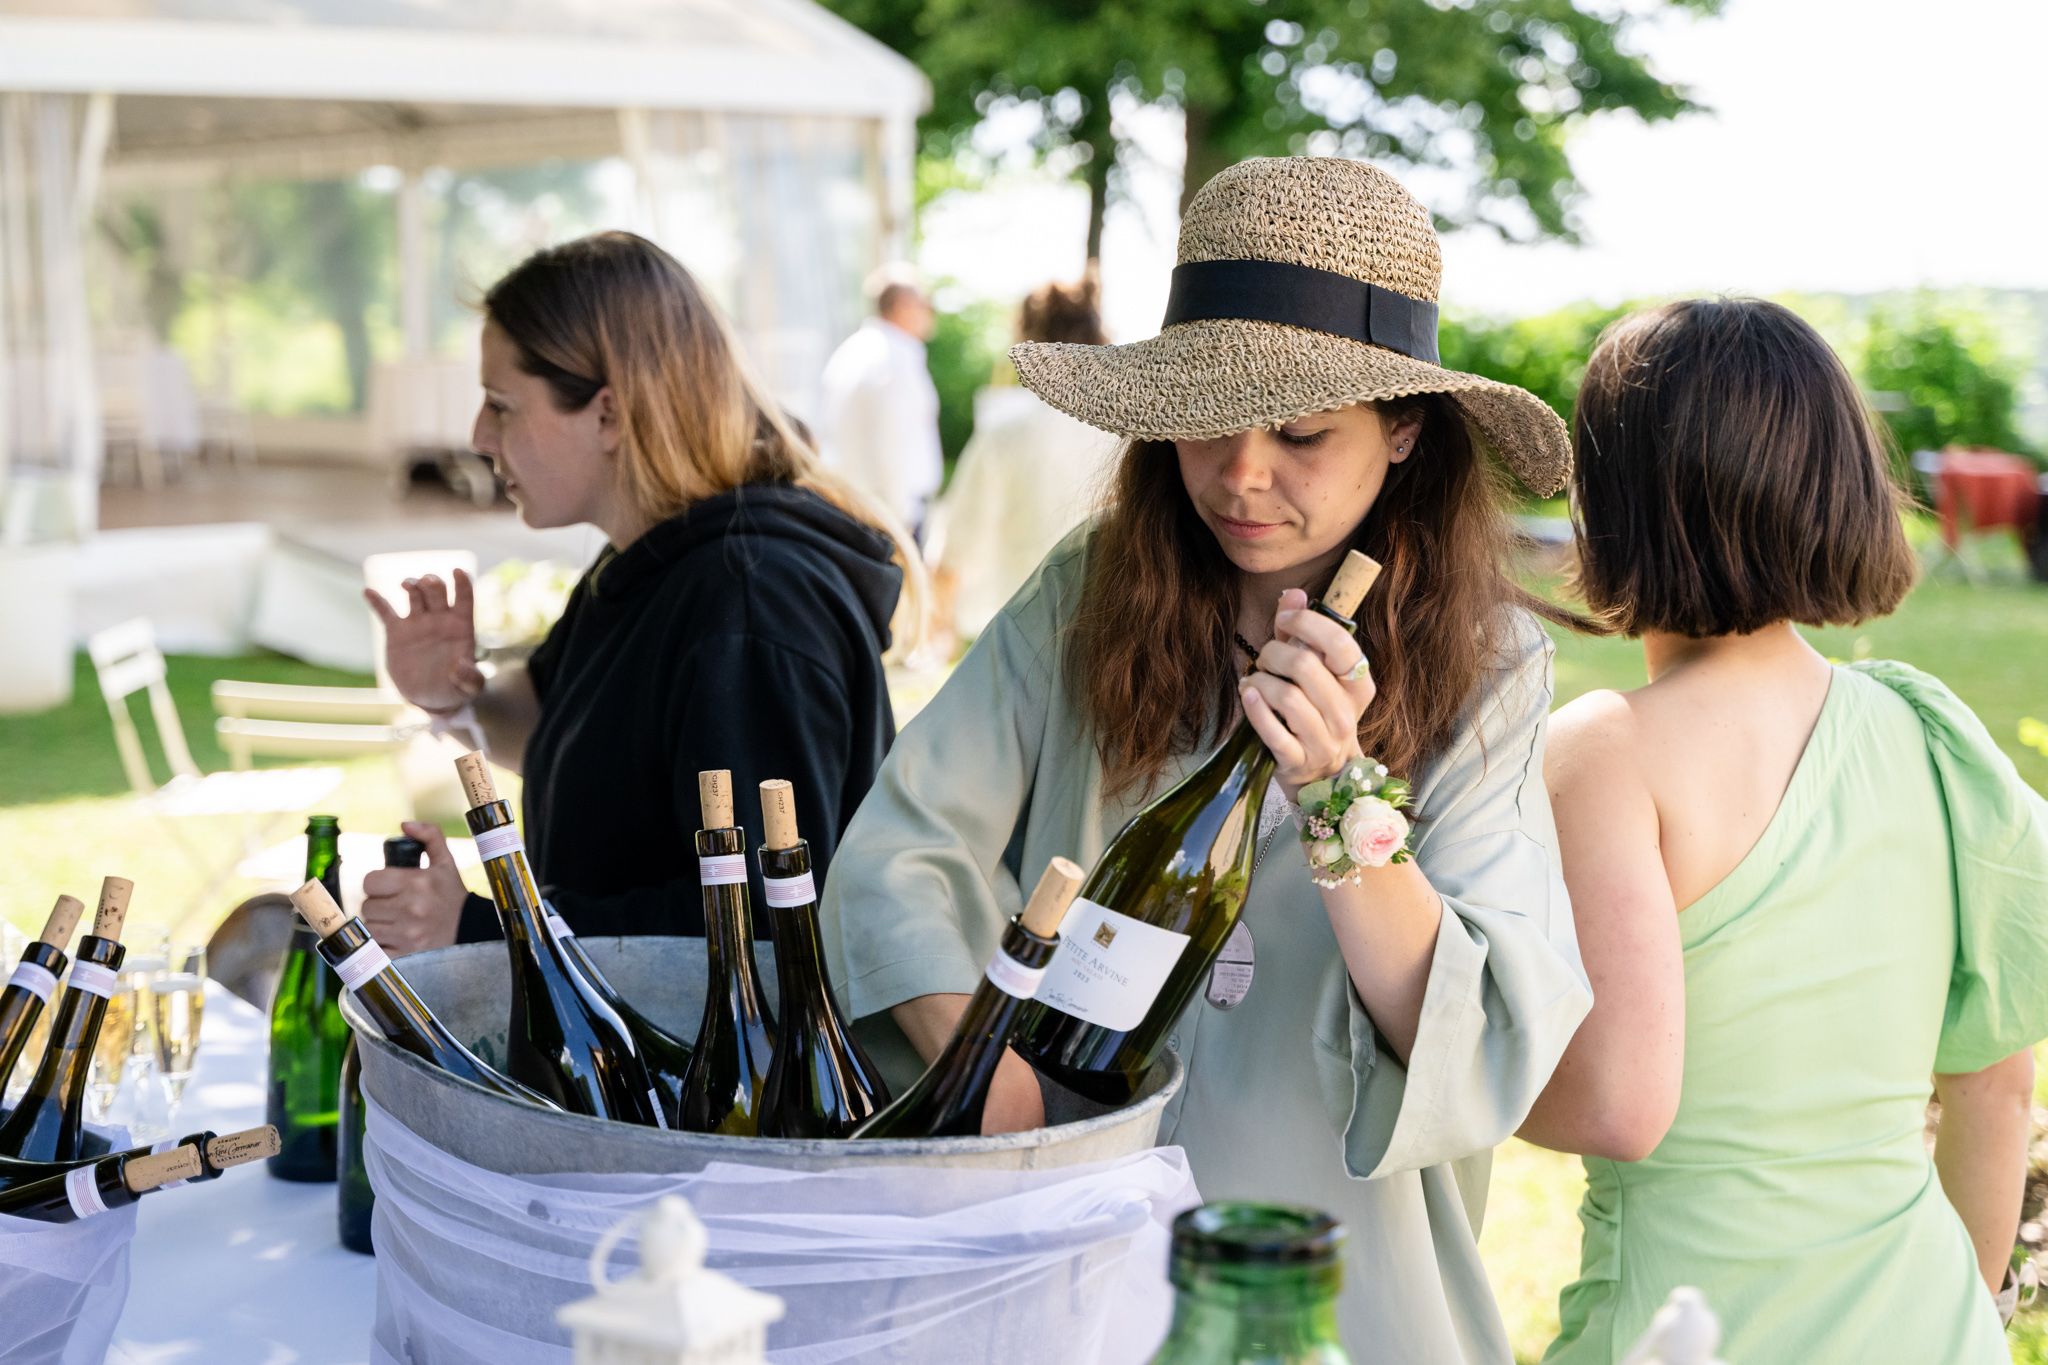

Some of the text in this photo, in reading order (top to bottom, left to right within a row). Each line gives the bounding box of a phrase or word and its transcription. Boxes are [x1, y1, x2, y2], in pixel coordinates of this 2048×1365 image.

[711, 774, 719, 797] CH237
[777, 791, 786, 814] CH237
[1062, 935, 1089, 962] PETITE
[1088, 957, 1129, 987] ARVINE
[1073, 969, 1090, 984] 2023
